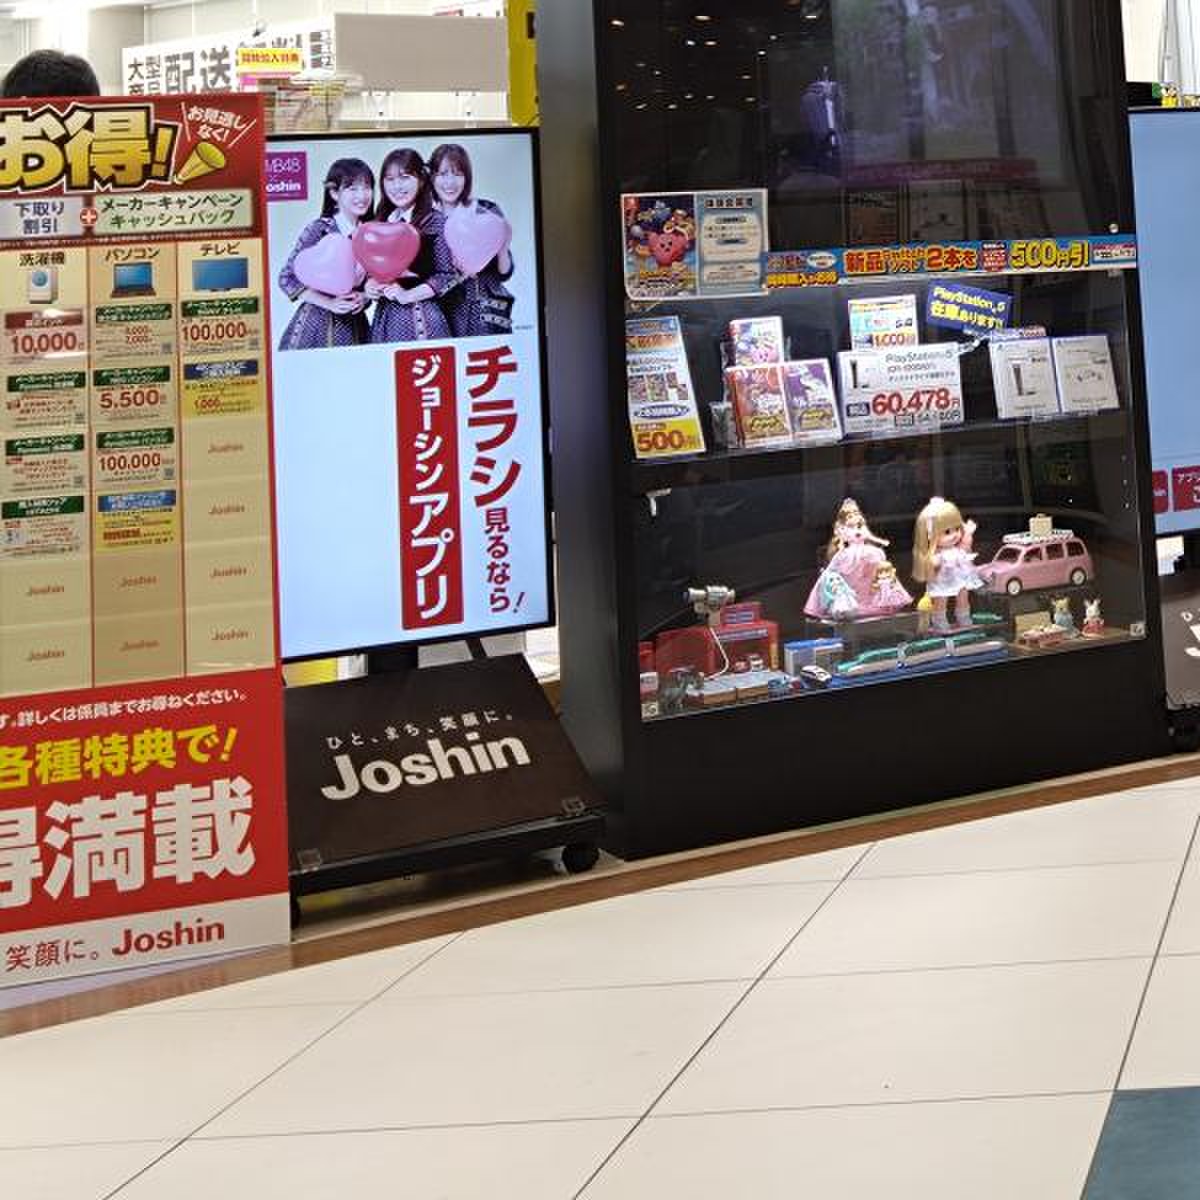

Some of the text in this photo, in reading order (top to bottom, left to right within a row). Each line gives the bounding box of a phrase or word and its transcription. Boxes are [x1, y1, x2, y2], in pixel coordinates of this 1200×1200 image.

[13, 192, 245, 217] 下取り メーカーキャンペーン
[22, 209, 236, 235] 割引 キャッシュバック
[105, 246, 161, 262] パソコン
[200, 240, 241, 256] テレビ
[409, 354, 455, 620] ジョーシンアプリ
[320, 731, 532, 801] Joshin
[111, 917, 225, 957] Joshin
